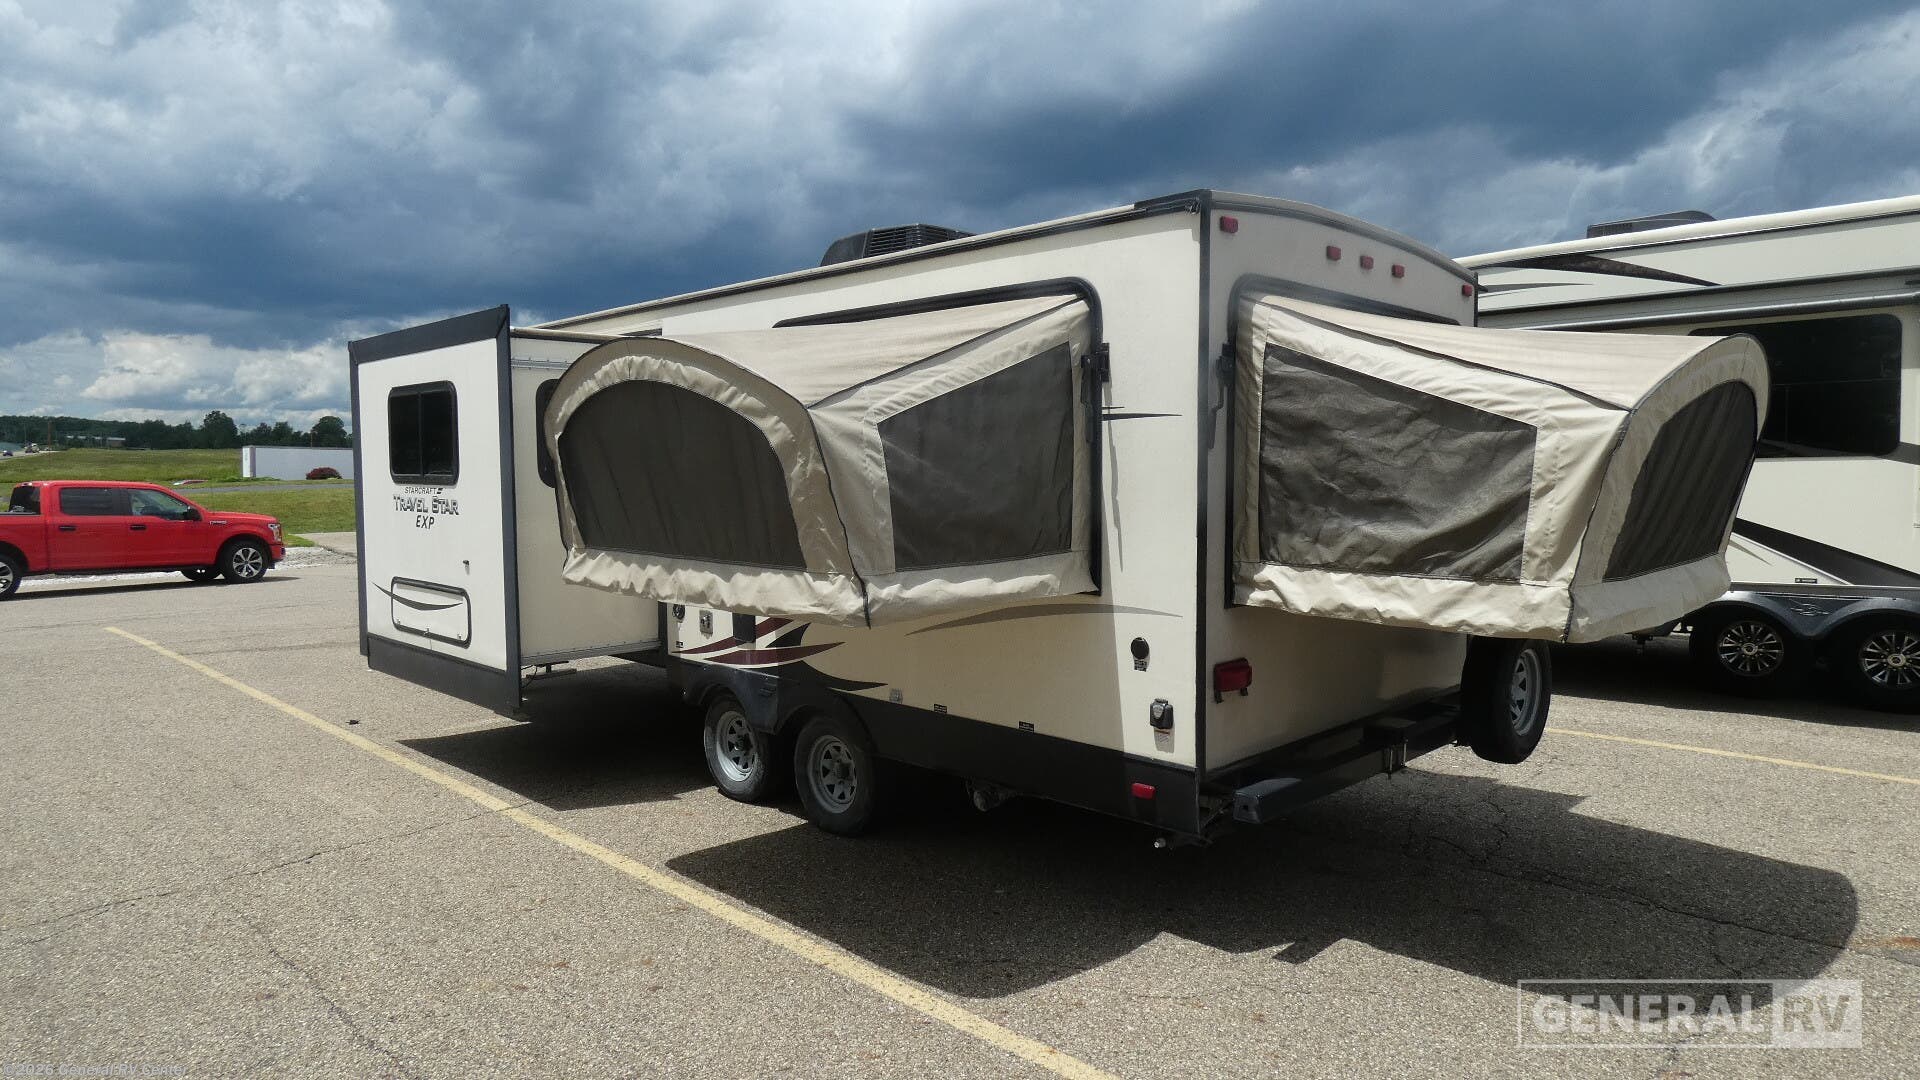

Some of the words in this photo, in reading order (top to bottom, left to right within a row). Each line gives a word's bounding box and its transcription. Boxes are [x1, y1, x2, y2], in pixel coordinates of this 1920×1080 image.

[404, 486, 437, 495] STARCRAFT
[393, 495, 428, 513] TRAVEL
[432, 495, 460, 516] STAR
[416, 515, 435, 530] EXP
